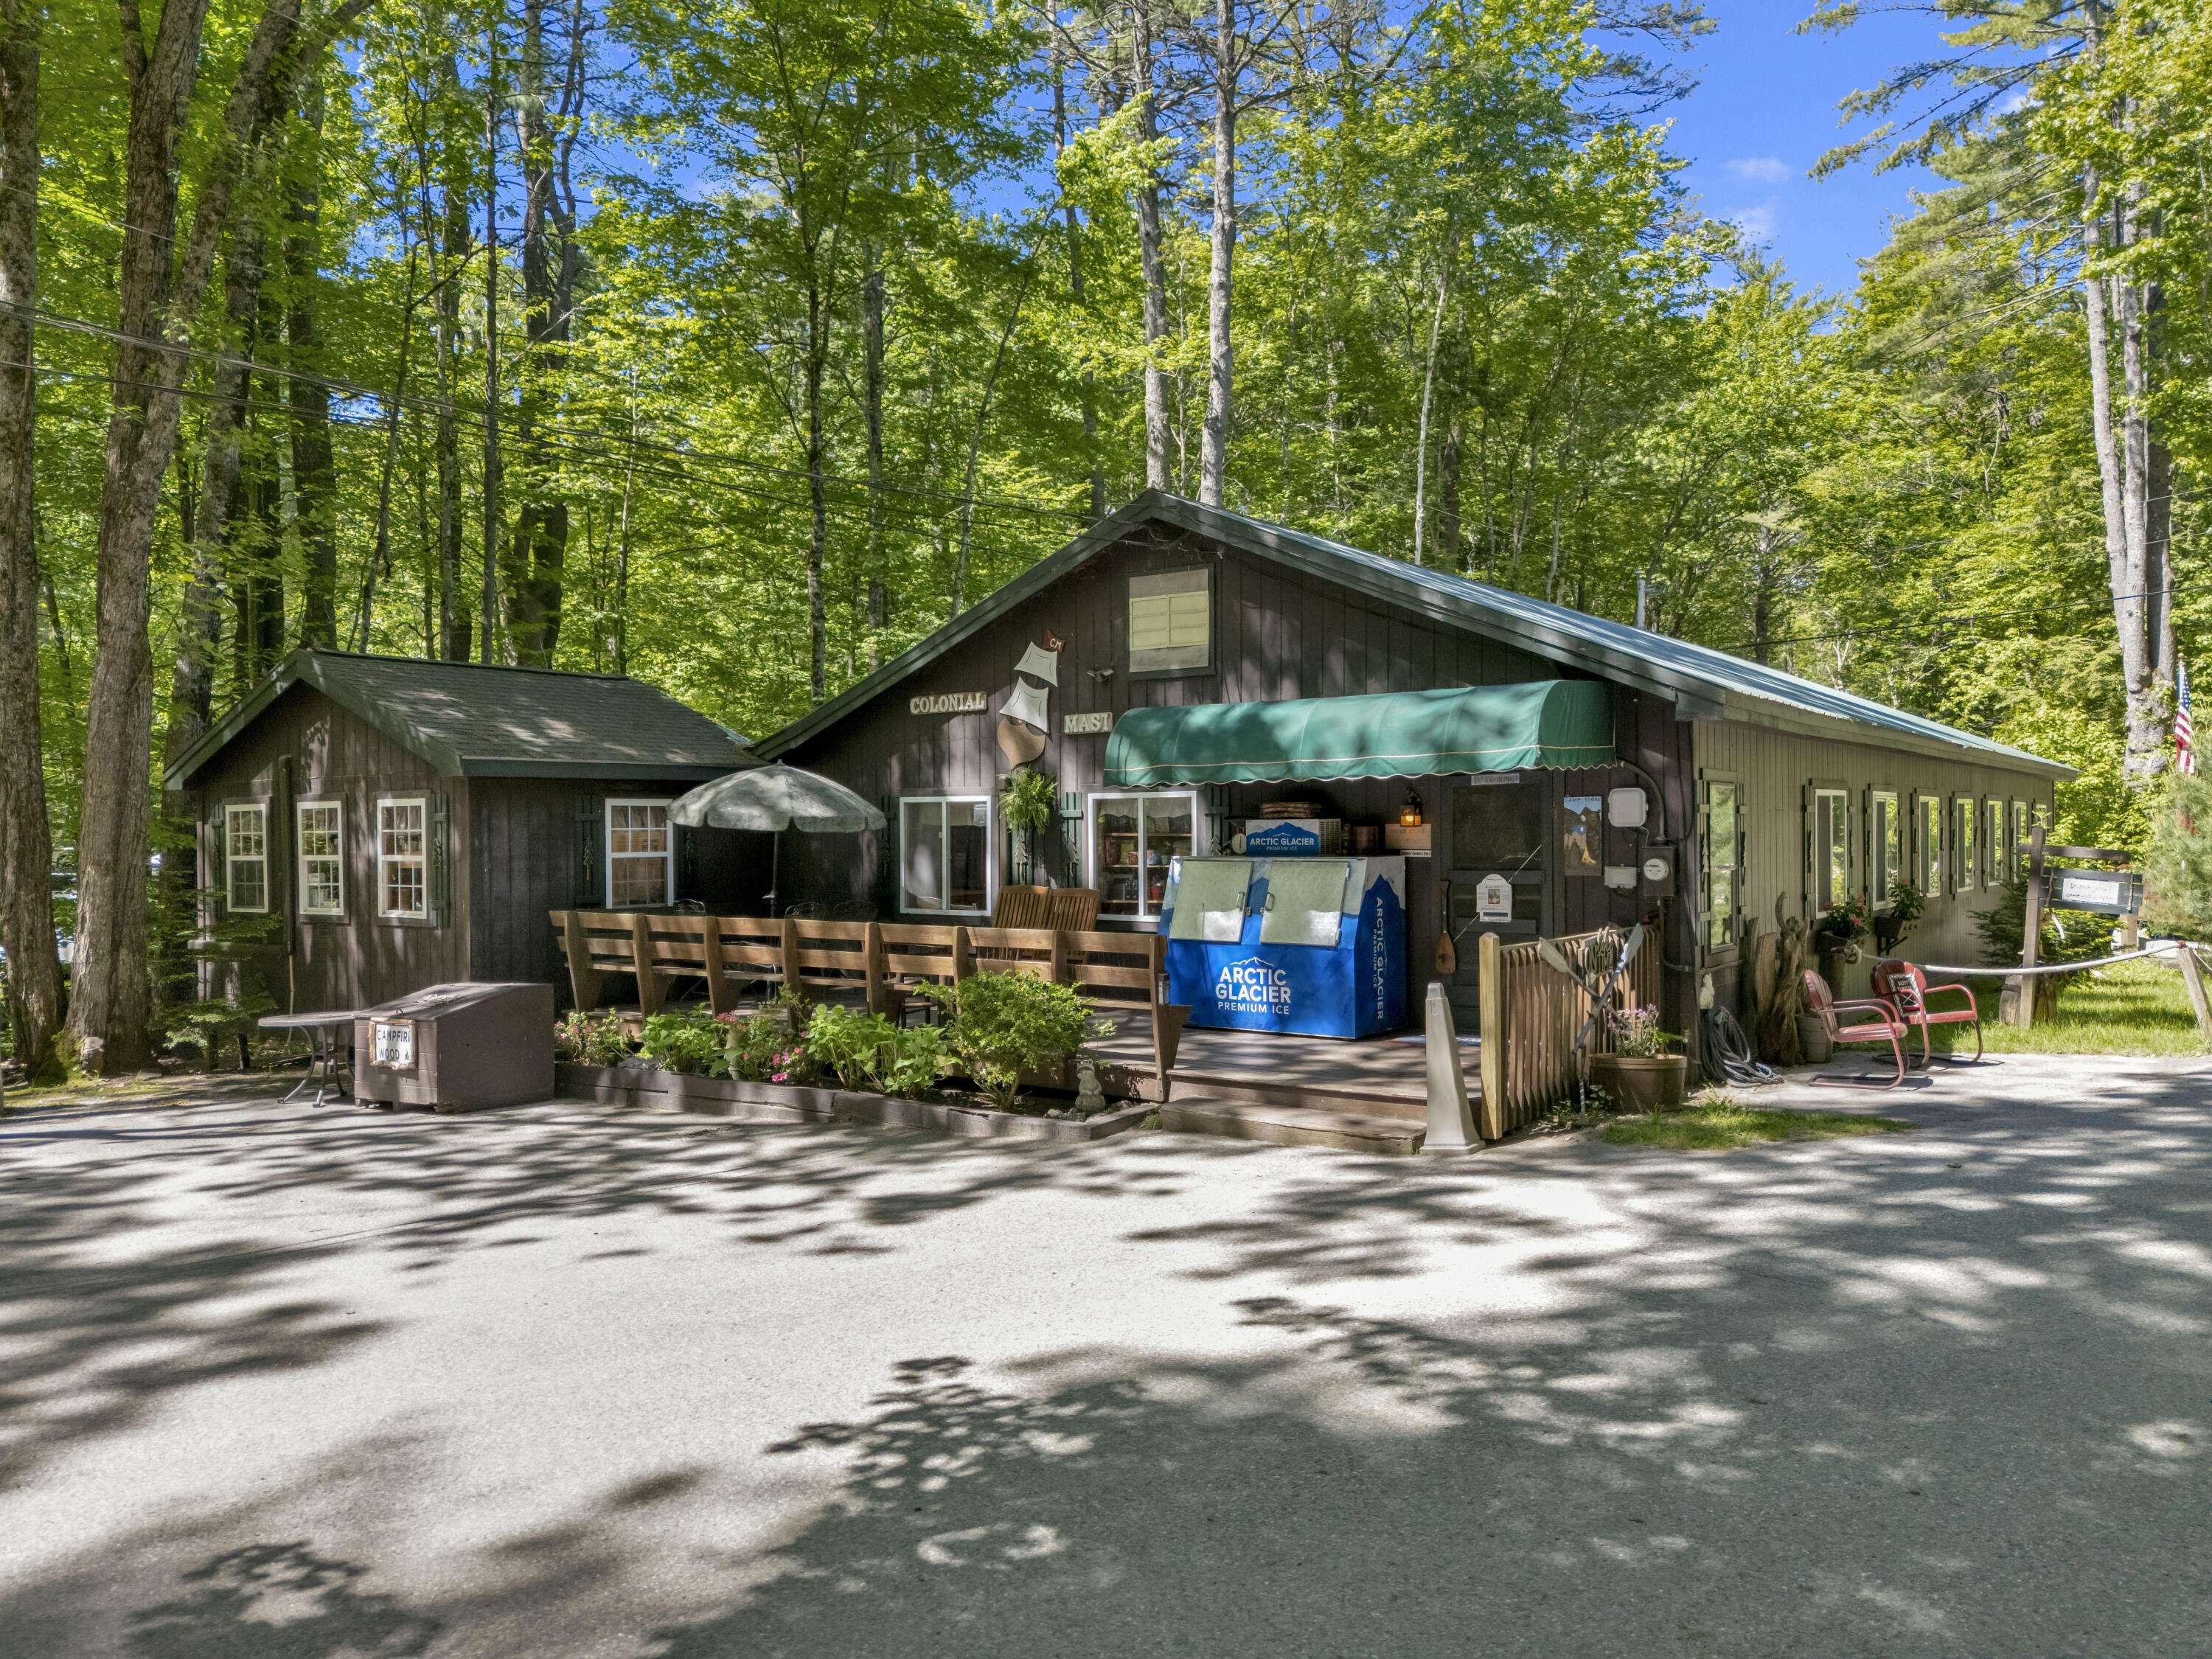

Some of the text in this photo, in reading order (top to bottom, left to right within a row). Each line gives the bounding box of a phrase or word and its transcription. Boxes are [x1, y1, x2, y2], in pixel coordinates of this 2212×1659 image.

[1049, 638, 1062, 650] CM
[909, 692, 985, 714] COLONIAL
[1065, 713, 1110, 733] MAST
[1250, 838, 1315, 846] ARCTIC GLACIER
[1219, 966, 1287, 986] ARCTIC
[1215, 983, 1291, 1004] GLACIER
[1218, 1001, 1290, 1015] PREMIUM ICE
[379, 1048, 400, 1060] WOOD
